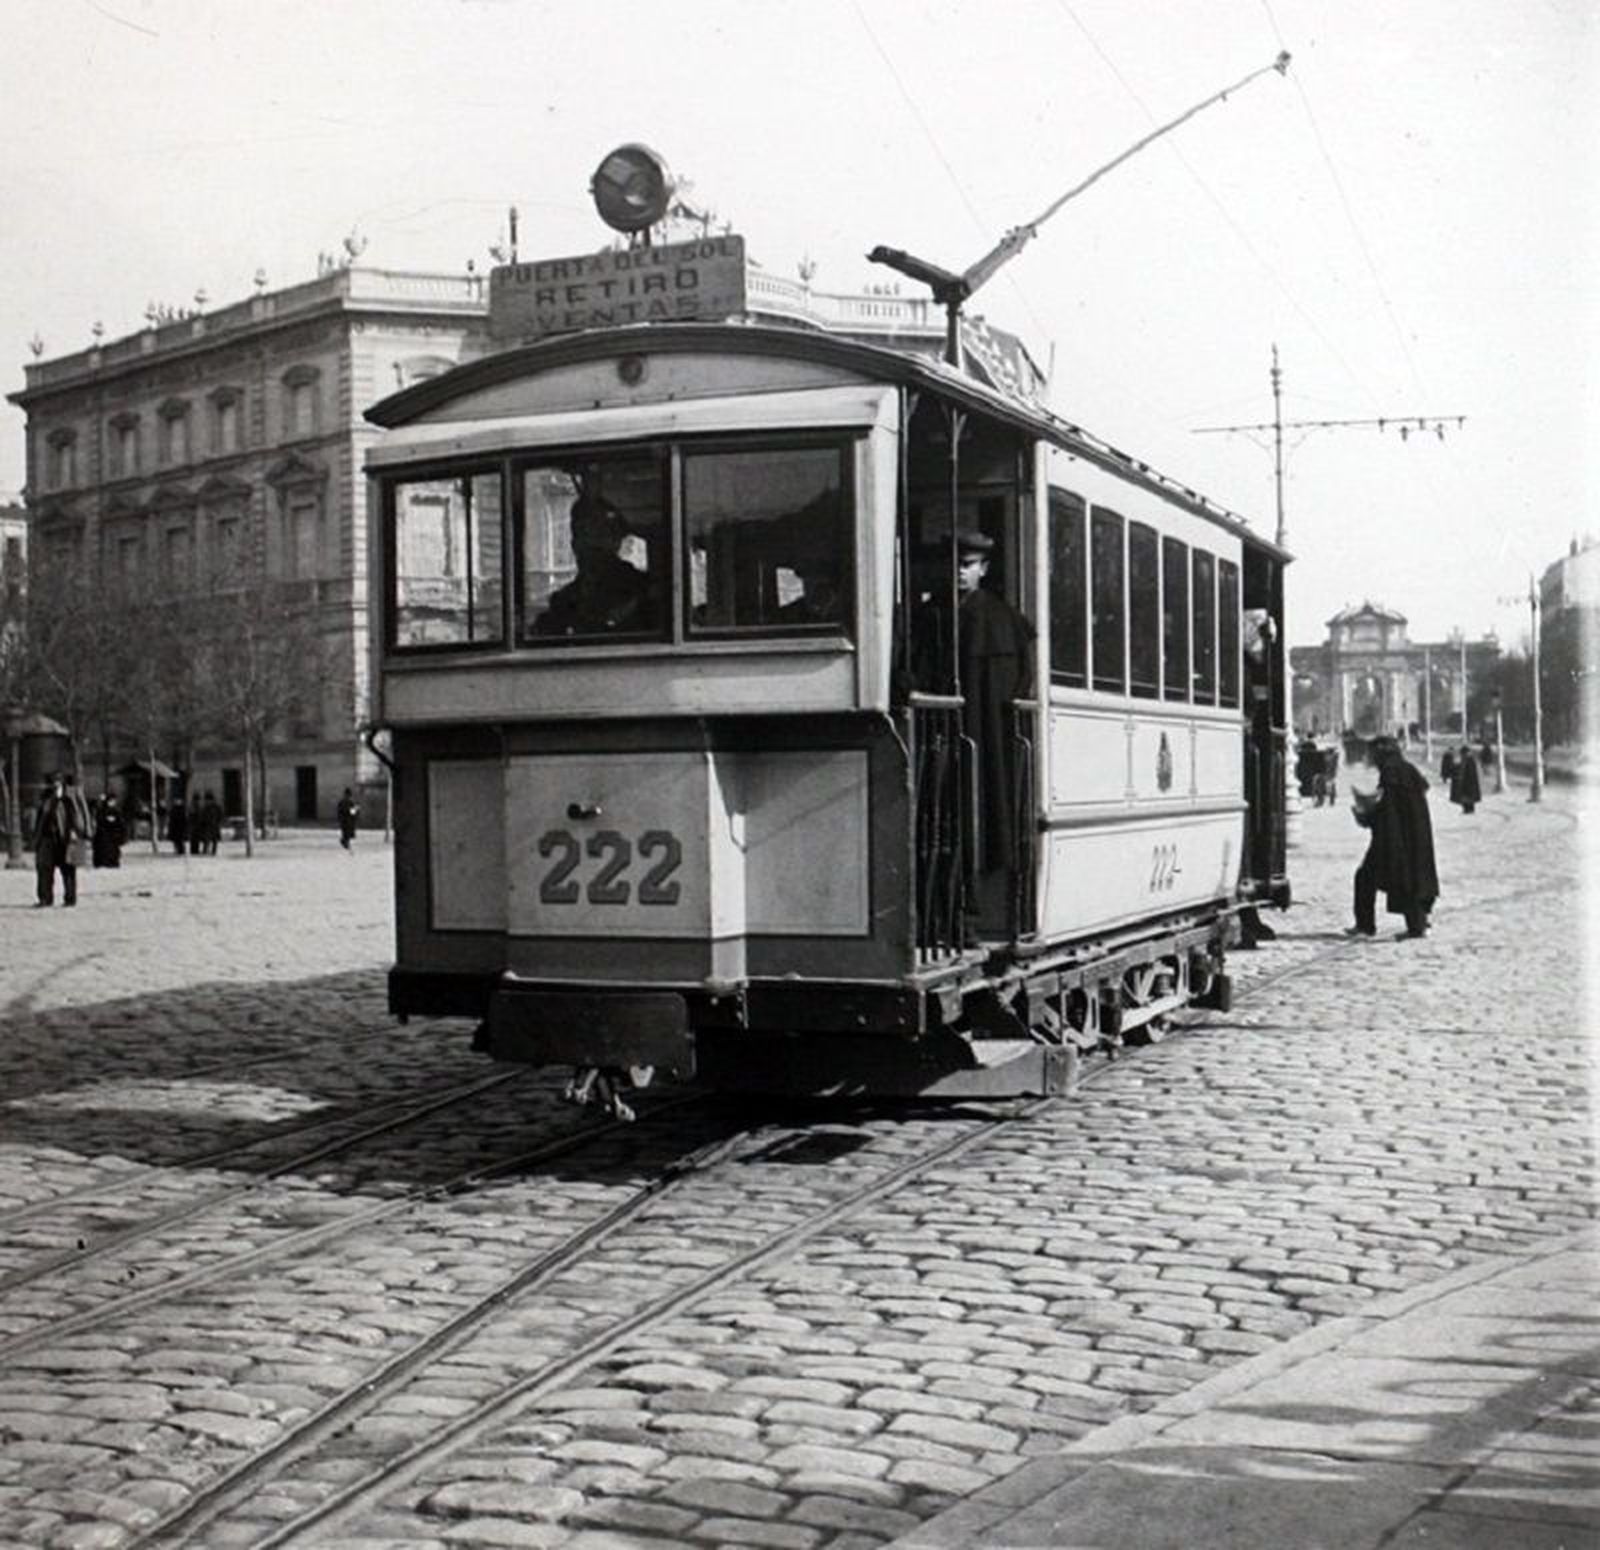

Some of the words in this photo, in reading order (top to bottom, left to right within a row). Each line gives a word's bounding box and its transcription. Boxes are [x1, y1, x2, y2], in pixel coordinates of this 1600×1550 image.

[502, 256, 607, 286] PUERTA
[614, 250, 666, 271] DEL
[684, 239, 735, 263] SOL
[535, 268, 699, 305] RETIRO
[536, 294, 699, 329] VENTAS
[538, 829, 683, 906] 222
